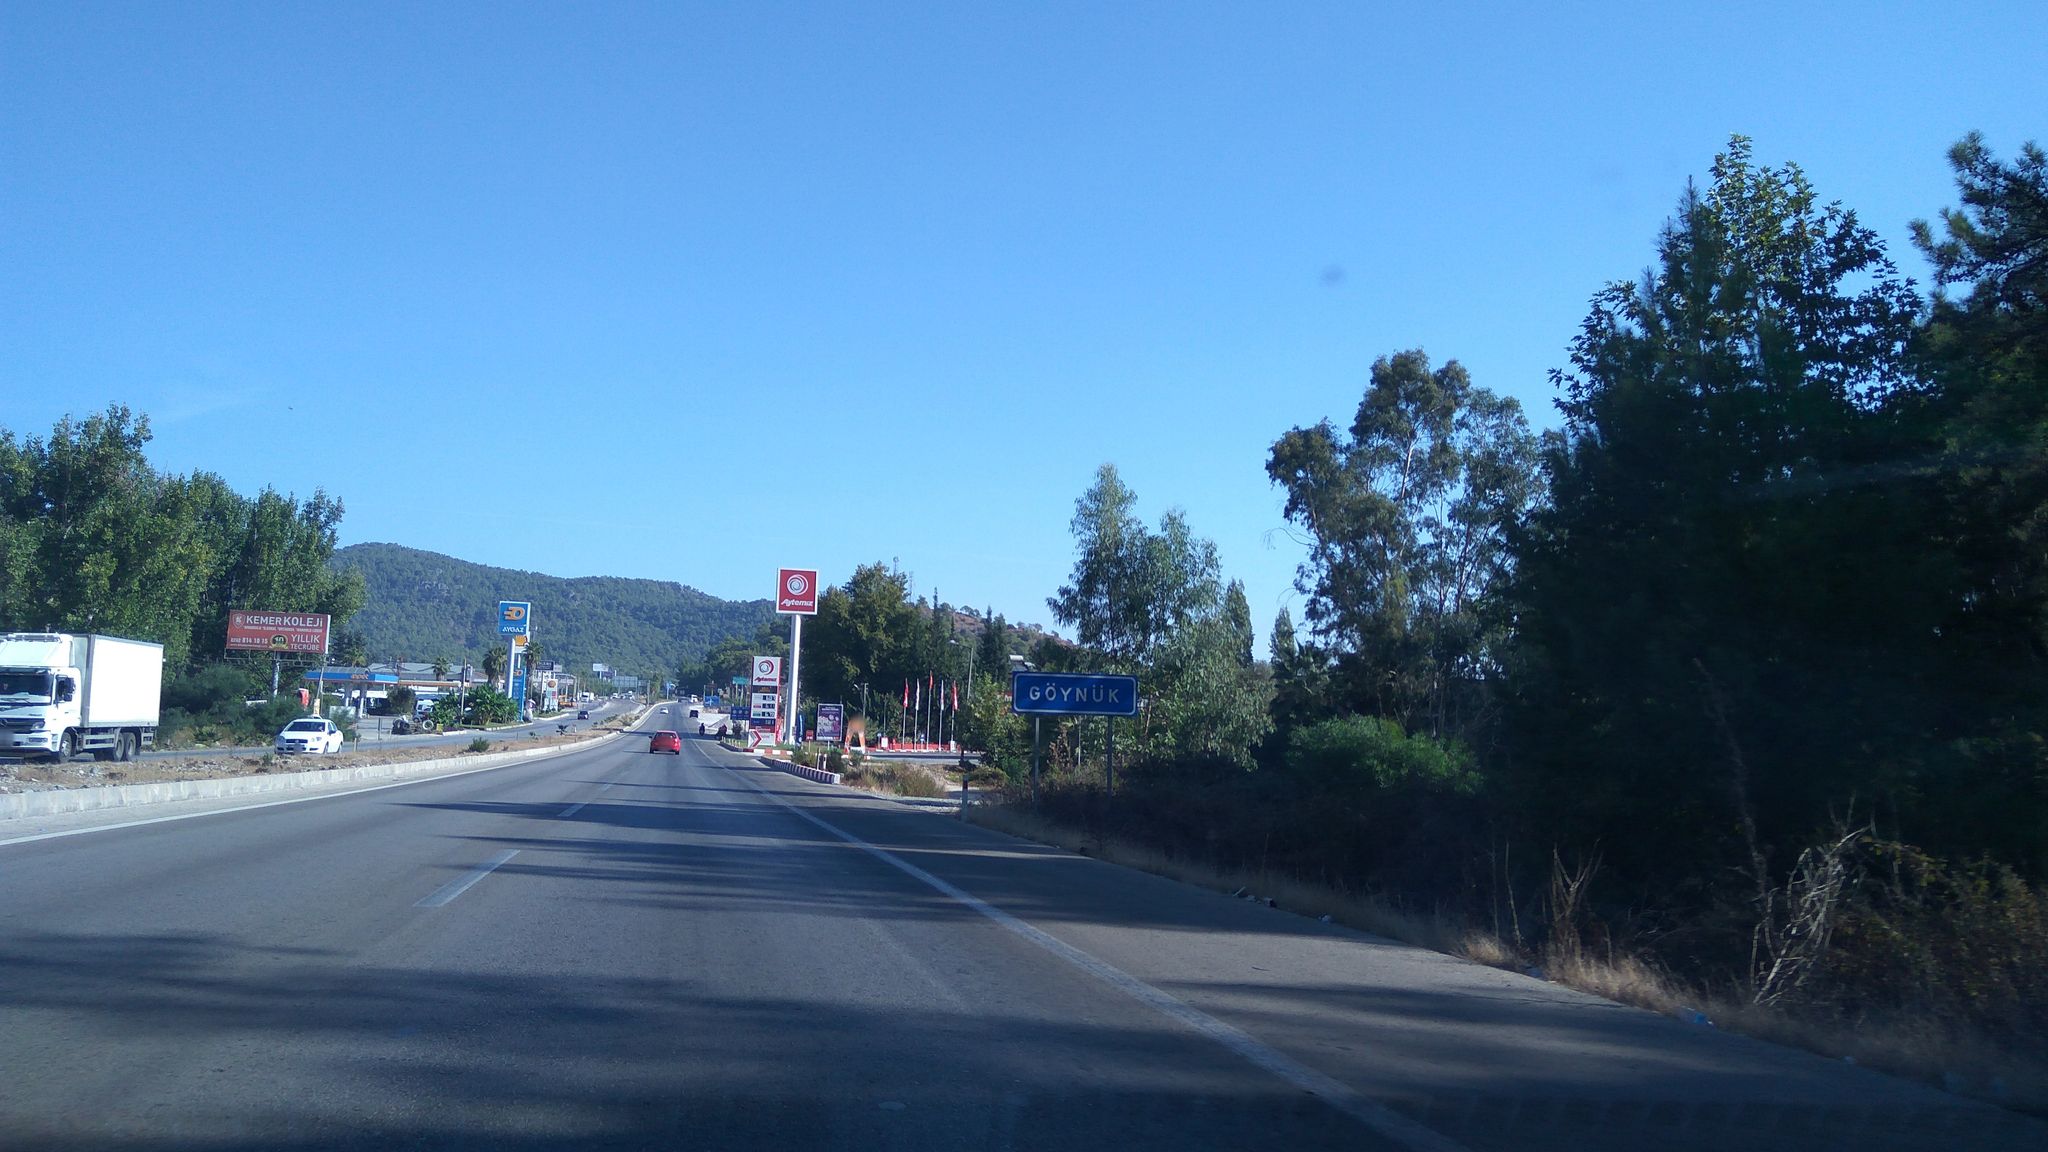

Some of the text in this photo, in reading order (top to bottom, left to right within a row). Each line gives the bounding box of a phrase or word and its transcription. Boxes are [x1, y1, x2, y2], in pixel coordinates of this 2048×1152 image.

[246, 615, 281, 625] KEMER
[291, 634, 320, 643] YILLIK
[1029, 682, 1119, 703] GÖYNÜK
